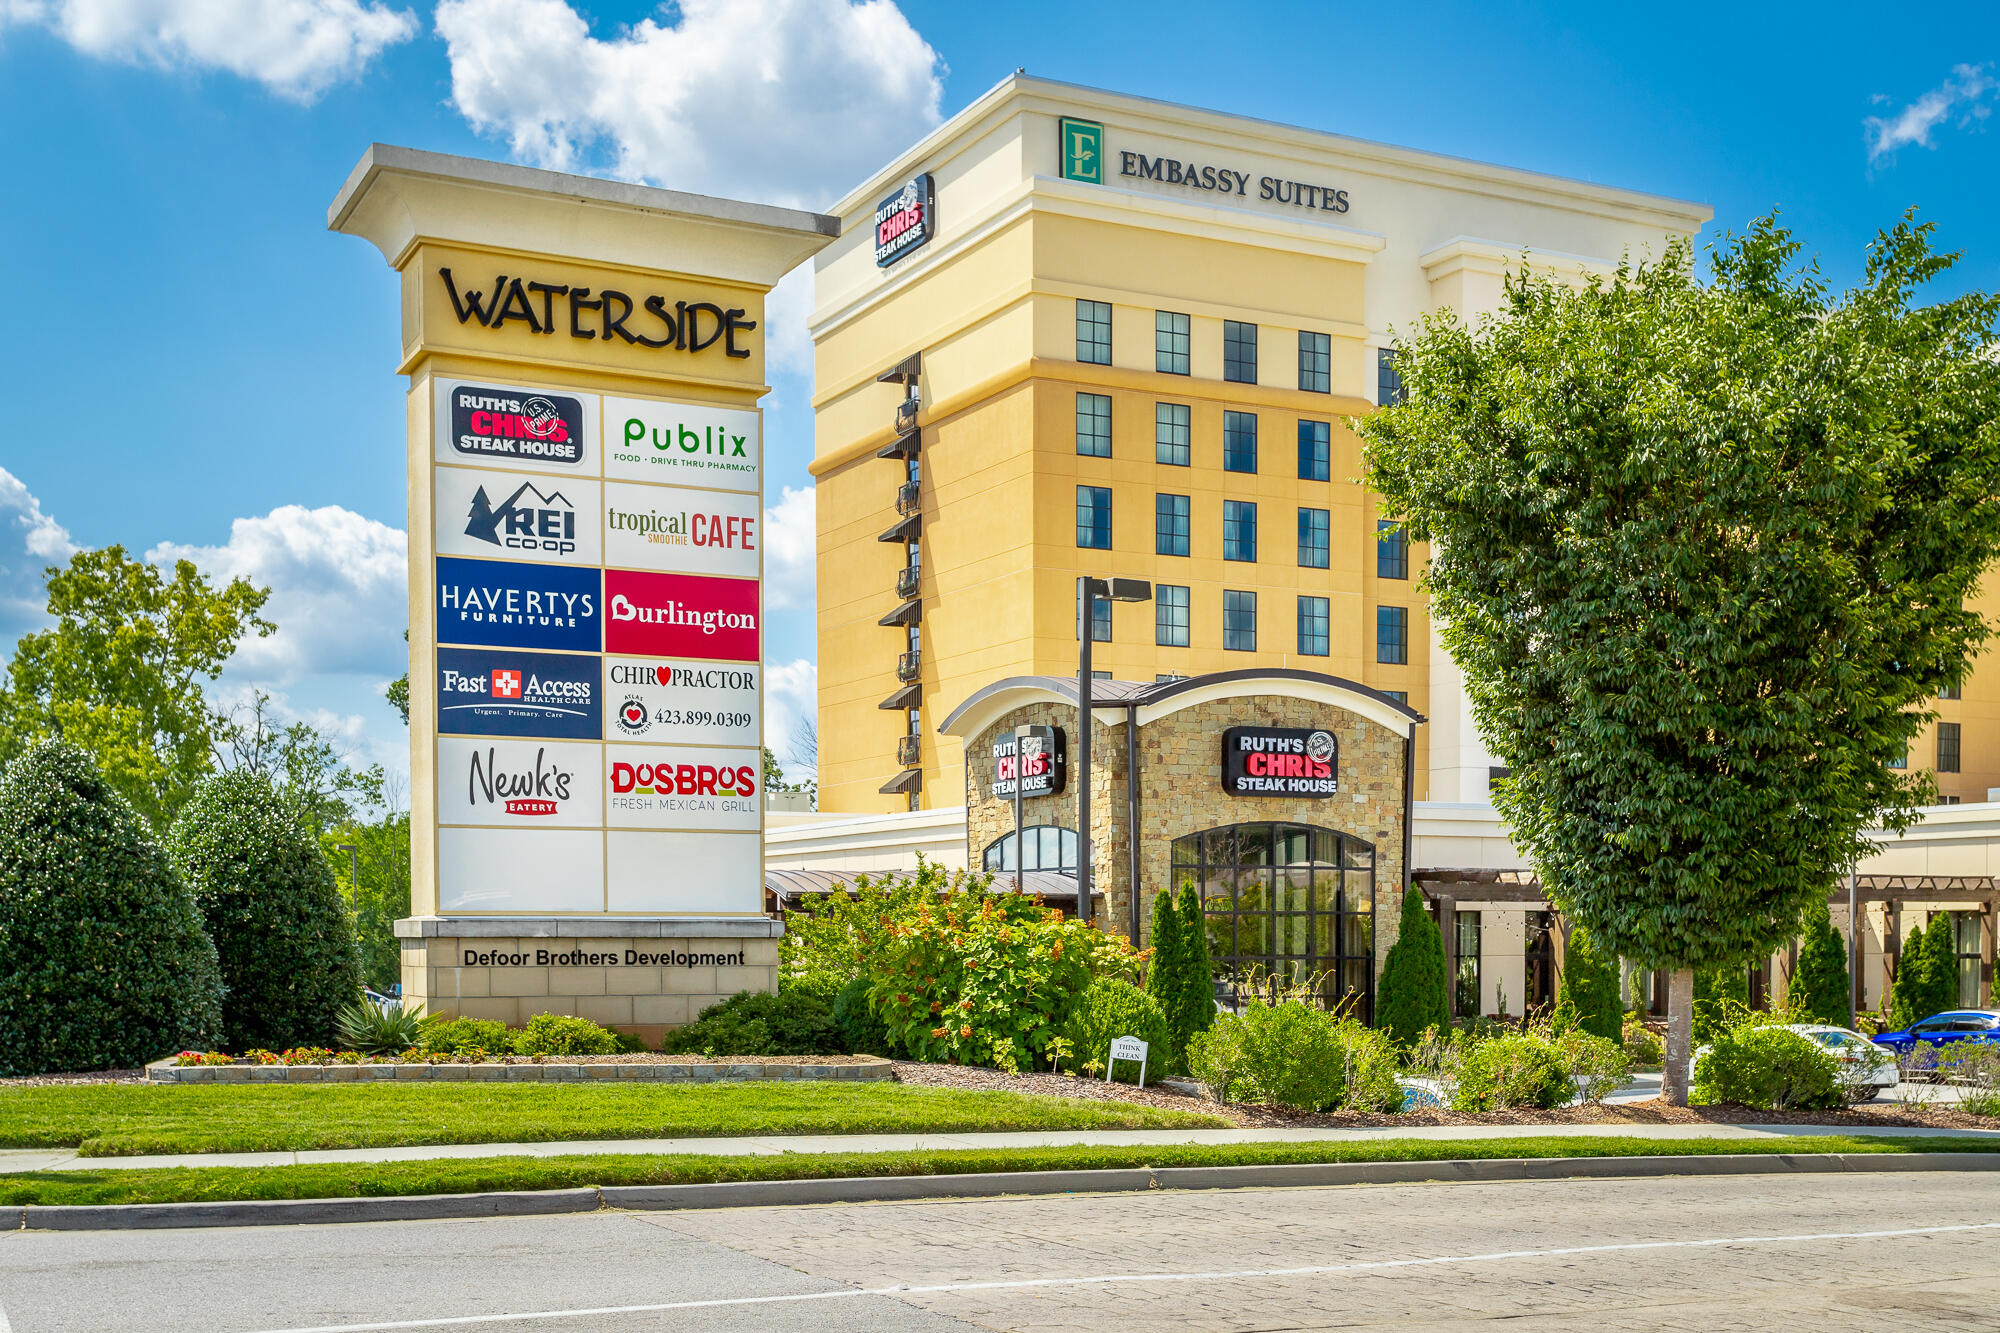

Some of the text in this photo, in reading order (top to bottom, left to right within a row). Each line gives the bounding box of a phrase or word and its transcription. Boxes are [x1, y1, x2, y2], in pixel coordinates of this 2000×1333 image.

[1120, 150, 1350, 214] EMBASSY SUITES
[874, 195, 906, 226] RUTH'S
[879, 203, 922, 246] CHRIS
[875, 222, 922, 262] STEAK HOUSE
[439, 268, 757, 358] WATERSIDE
[459, 394, 520, 413] RUTH'S
[471, 411, 568, 443] CHRIS
[530, 409, 556, 431] PRIME
[460, 435, 576, 458] STEAK HOUSE
[624, 418, 747, 457] Publix
[614, 453, 756, 473] FOOD DRIVE THRU PHARMACY
[505, 507, 575, 539] REI
[608, 507, 688, 536] tropical
[692, 513, 755, 550] CAFE
[647, 533, 688, 546] SMOOTHIE
[442, 585, 594, 617] HAVERTYS
[461, 611, 576, 628] FURNITURE
[611, 594, 756, 635] Burlington
[442, 670, 591, 698] Fast Access
[610, 665, 755, 690] CHIRPRACTOR
[545, 711, 563, 719] Care
[655, 708, 751, 728] 423.899.0309
[1240, 736, 1304, 753] RUTH'S
[469, 747, 571, 805] Newk's
[1247, 752, 1331, 779] CHRIS
[1237, 777, 1337, 793] STEAK HOUSE
[509, 802, 554, 812] EATERY
[612, 798, 755, 812] FRESH MEXICAN GRILL
[464, 950, 745, 969] Defoor Brothers Development
[1119, 1043, 1141, 1051] THINK
